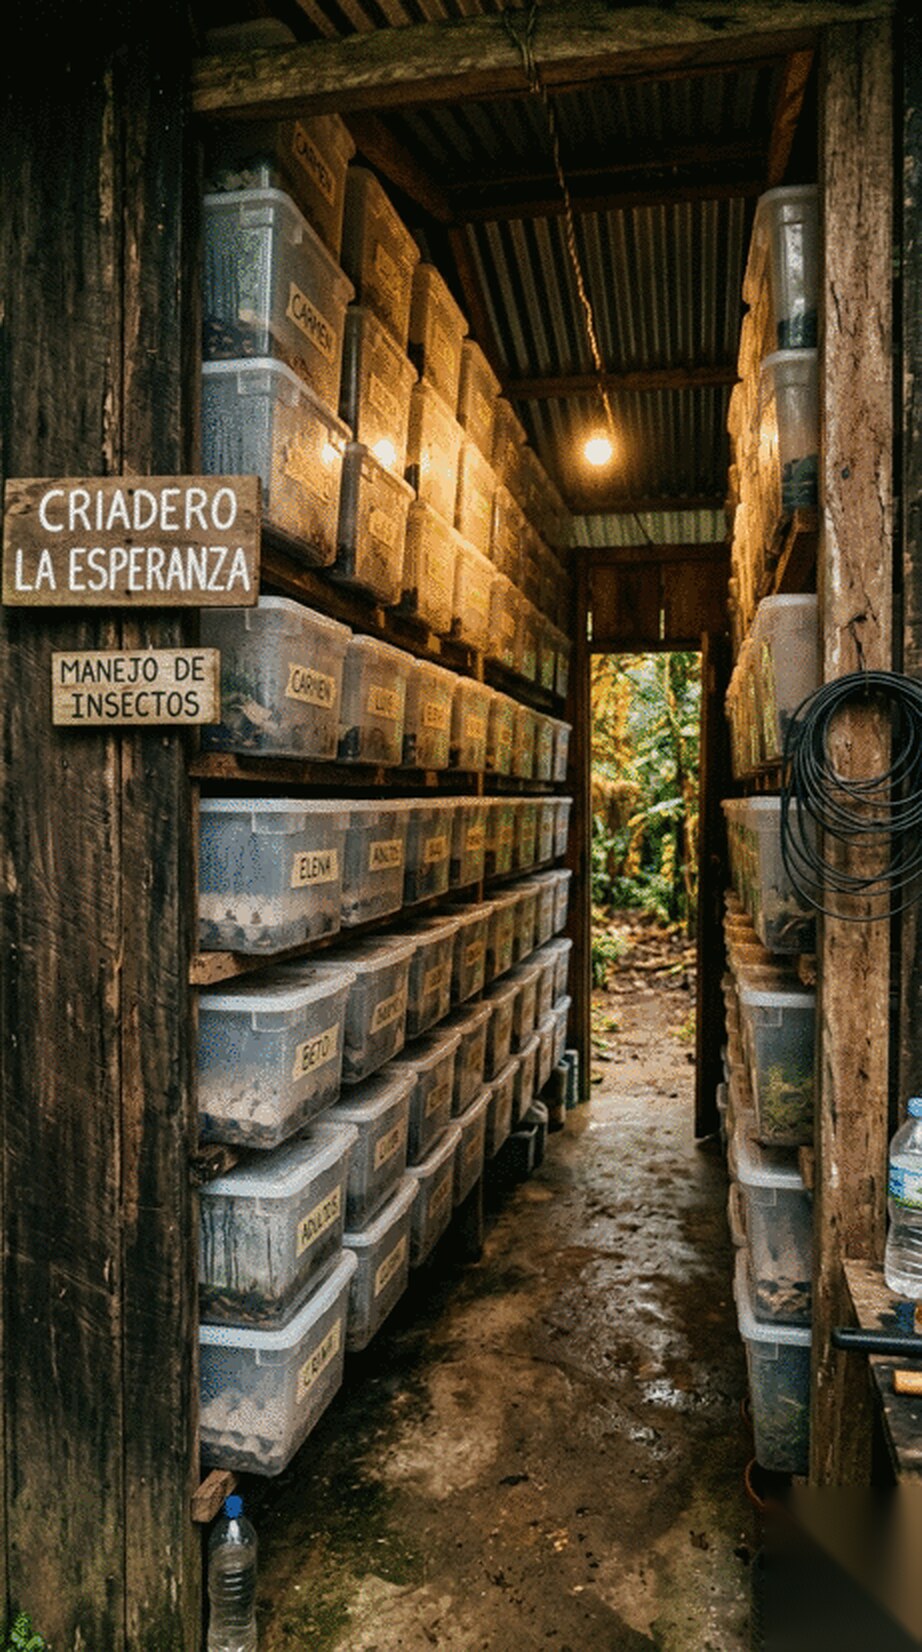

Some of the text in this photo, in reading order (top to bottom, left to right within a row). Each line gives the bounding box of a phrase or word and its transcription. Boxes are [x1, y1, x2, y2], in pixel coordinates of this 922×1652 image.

[291, 293, 333, 350] CARMEN
[39, 488, 237, 532] CRIADERO
[15, 547, 251, 592] LA ESPERANZA
[60, 656, 205, 683] MANEJO DE
[292, 669, 331, 699] CARMEN
[71, 691, 200, 718] INSECTOS
[300, 856, 331, 880] ELENA
[302, 1034, 330, 1071] BETO
